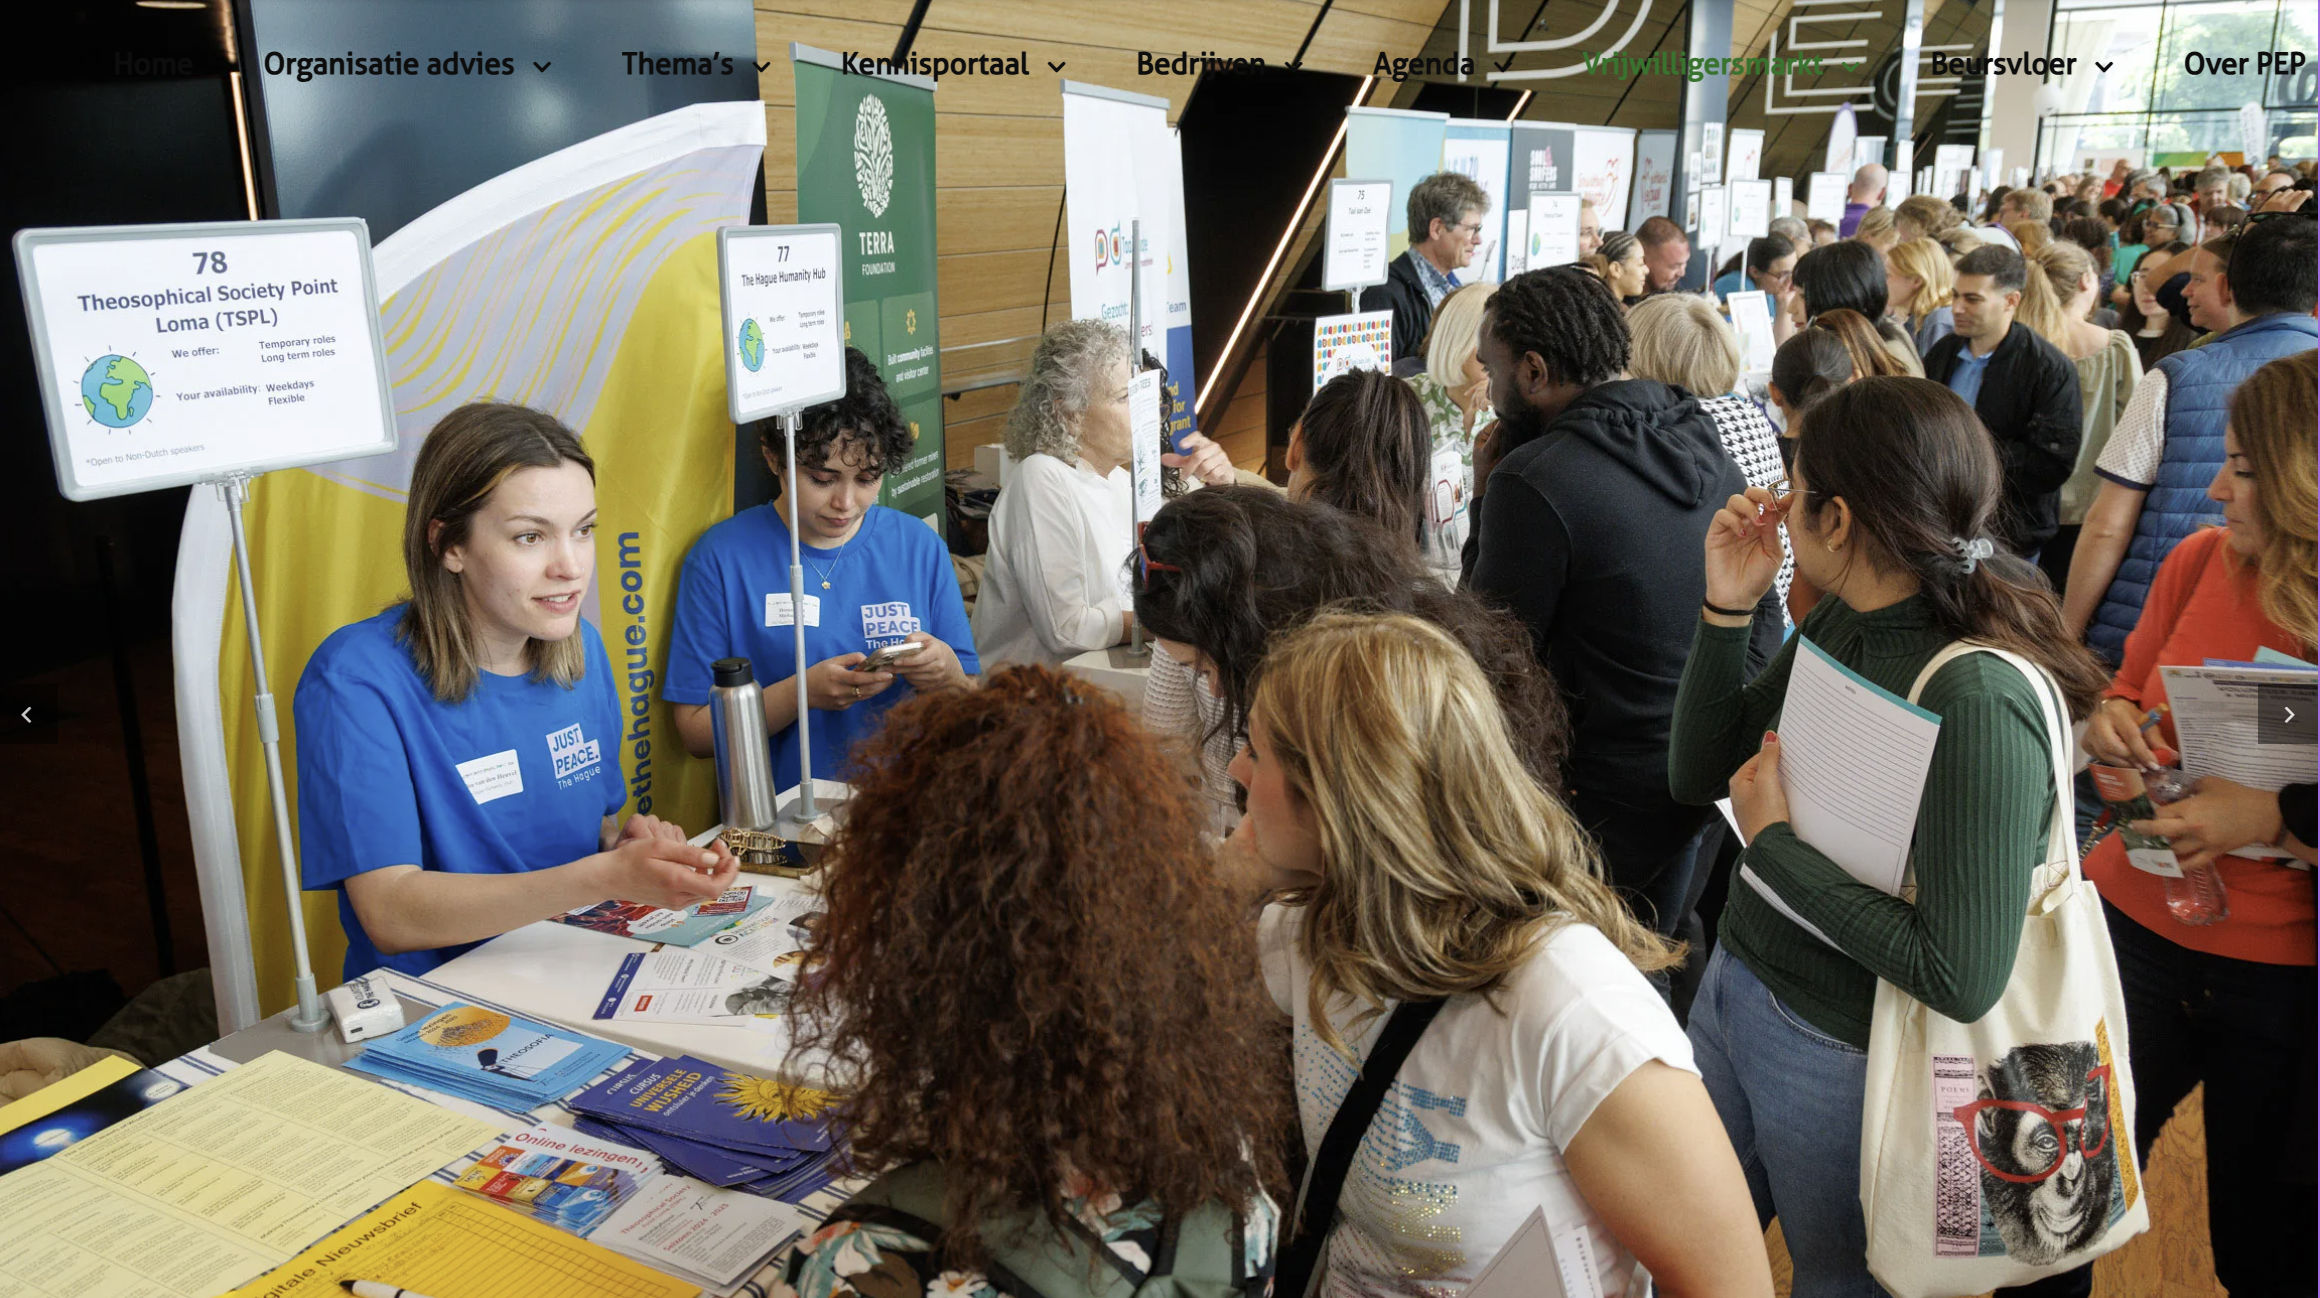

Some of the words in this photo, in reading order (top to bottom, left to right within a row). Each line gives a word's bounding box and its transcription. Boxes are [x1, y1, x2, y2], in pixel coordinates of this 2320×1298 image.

[777, 245, 790, 263] 77
[858, 231, 895, 256] TERRA
[192, 250, 229, 275] 78
[861, 261, 896, 276] FOUNDATION
[741, 273, 755, 287] The
[755, 272, 778, 288] Hague
[778, 268, 812, 283] Humanity
[812, 267, 826, 280] Hub
[77, 286, 213, 312] Theosophical
[217, 280, 285, 303] Society
[291, 278, 339, 297] Point
[155, 316, 210, 334] Loma
[215, 307, 279, 332] (TSPL)
[172, 349, 189, 359] We
[191, 346, 220, 357] offer:
[259, 337, 310, 351] Temporary
[312, 335, 337, 345] roles
[261, 353, 284, 364] Long
[286, 351, 311, 361] term
[312, 348, 336, 359] roles
[176, 391, 200, 402] Your
[265, 379, 315, 394] Weekdays
[268, 394, 306, 406] Flexible
[864, 604, 908, 619] JUST
[866, 639, 889, 650] The
[553, 727, 580, 753] JUST
[555, 746, 600, 776] PEACE.
[557, 776, 574, 790] The
[574, 765, 601, 784] Hague
[501, 1032, 556, 1064] THEOSOFIA
[629, 1073, 662, 1095] CURSUS
[629, 1068, 688, 1108] UNIVERSELE
[643, 1071, 703, 1112] WIJSHEID
[515, 1132, 567, 1151] Online
[568, 1143, 638, 1169] lezingen
[262, 1267, 317, 1298] gitale
[315, 1201, 423, 1267] Nieuwsbrief
